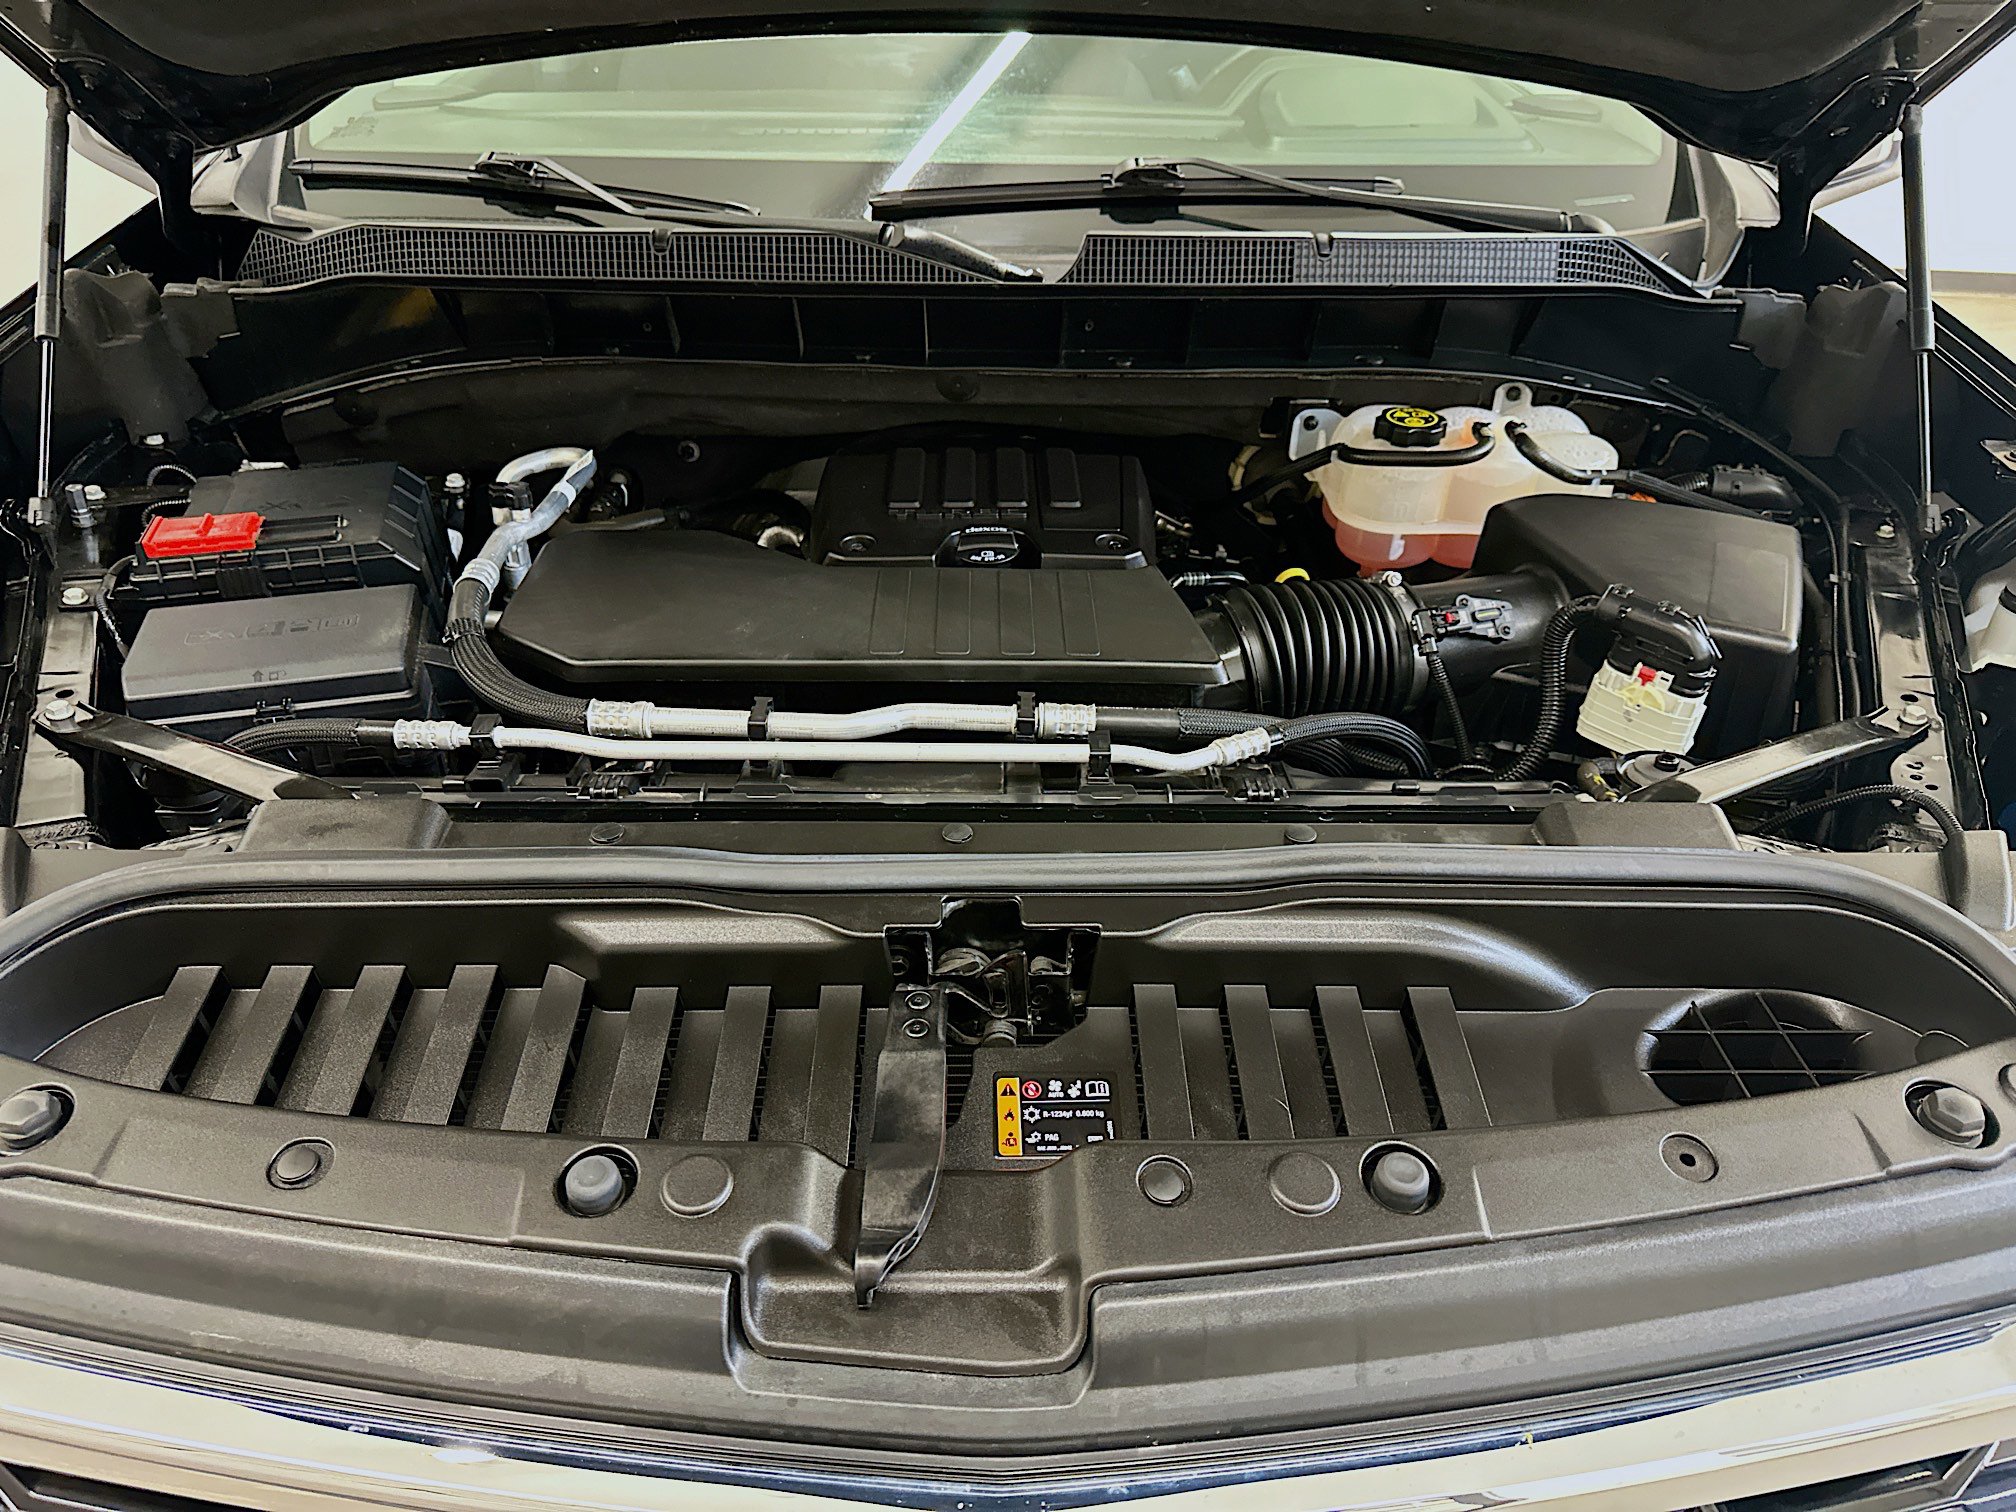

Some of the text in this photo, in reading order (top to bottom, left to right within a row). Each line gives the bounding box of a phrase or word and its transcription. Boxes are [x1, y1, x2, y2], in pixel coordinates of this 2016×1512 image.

[1042, 1110, 1073, 1118] R-1234yf
[1095, 1110, 1104, 1118] kg
[1044, 1133, 1060, 1141] PAG
